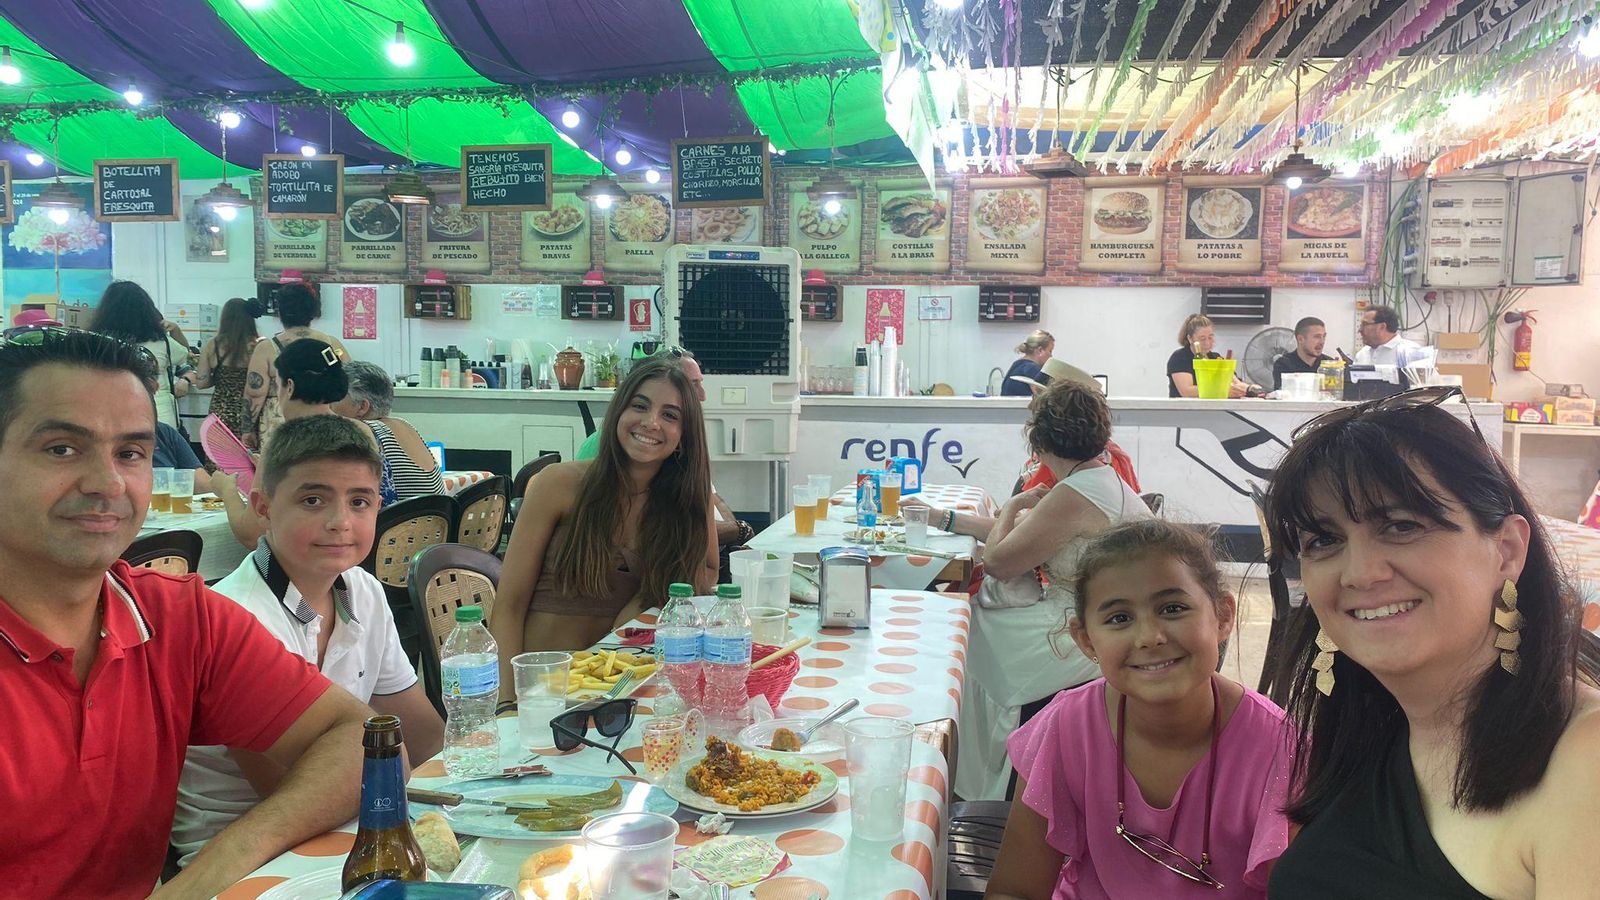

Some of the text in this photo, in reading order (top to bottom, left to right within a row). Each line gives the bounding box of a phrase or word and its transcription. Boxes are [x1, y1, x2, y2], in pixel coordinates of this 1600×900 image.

[680, 145, 750, 158] CARNES A LA
[469, 153, 519, 164] TENEMOS
[103, 166, 161, 178] BOTELLITA
[504, 162, 544, 173] FRESQUITA
[738, 166, 762, 176] POLLO,
[272, 170, 300, 179] ADOBO
[524, 172, 544, 182] BIEN
[104, 181, 115, 189] DE
[722, 177, 762, 187] MORCILLA,
[324, 184, 333, 192] DE
[104, 188, 152, 200] CARTOJAL
[473, 188, 506, 199] HECHO
[104, 202, 155, 212] FRESQUITA
[841, 428, 962, 474] renfe
